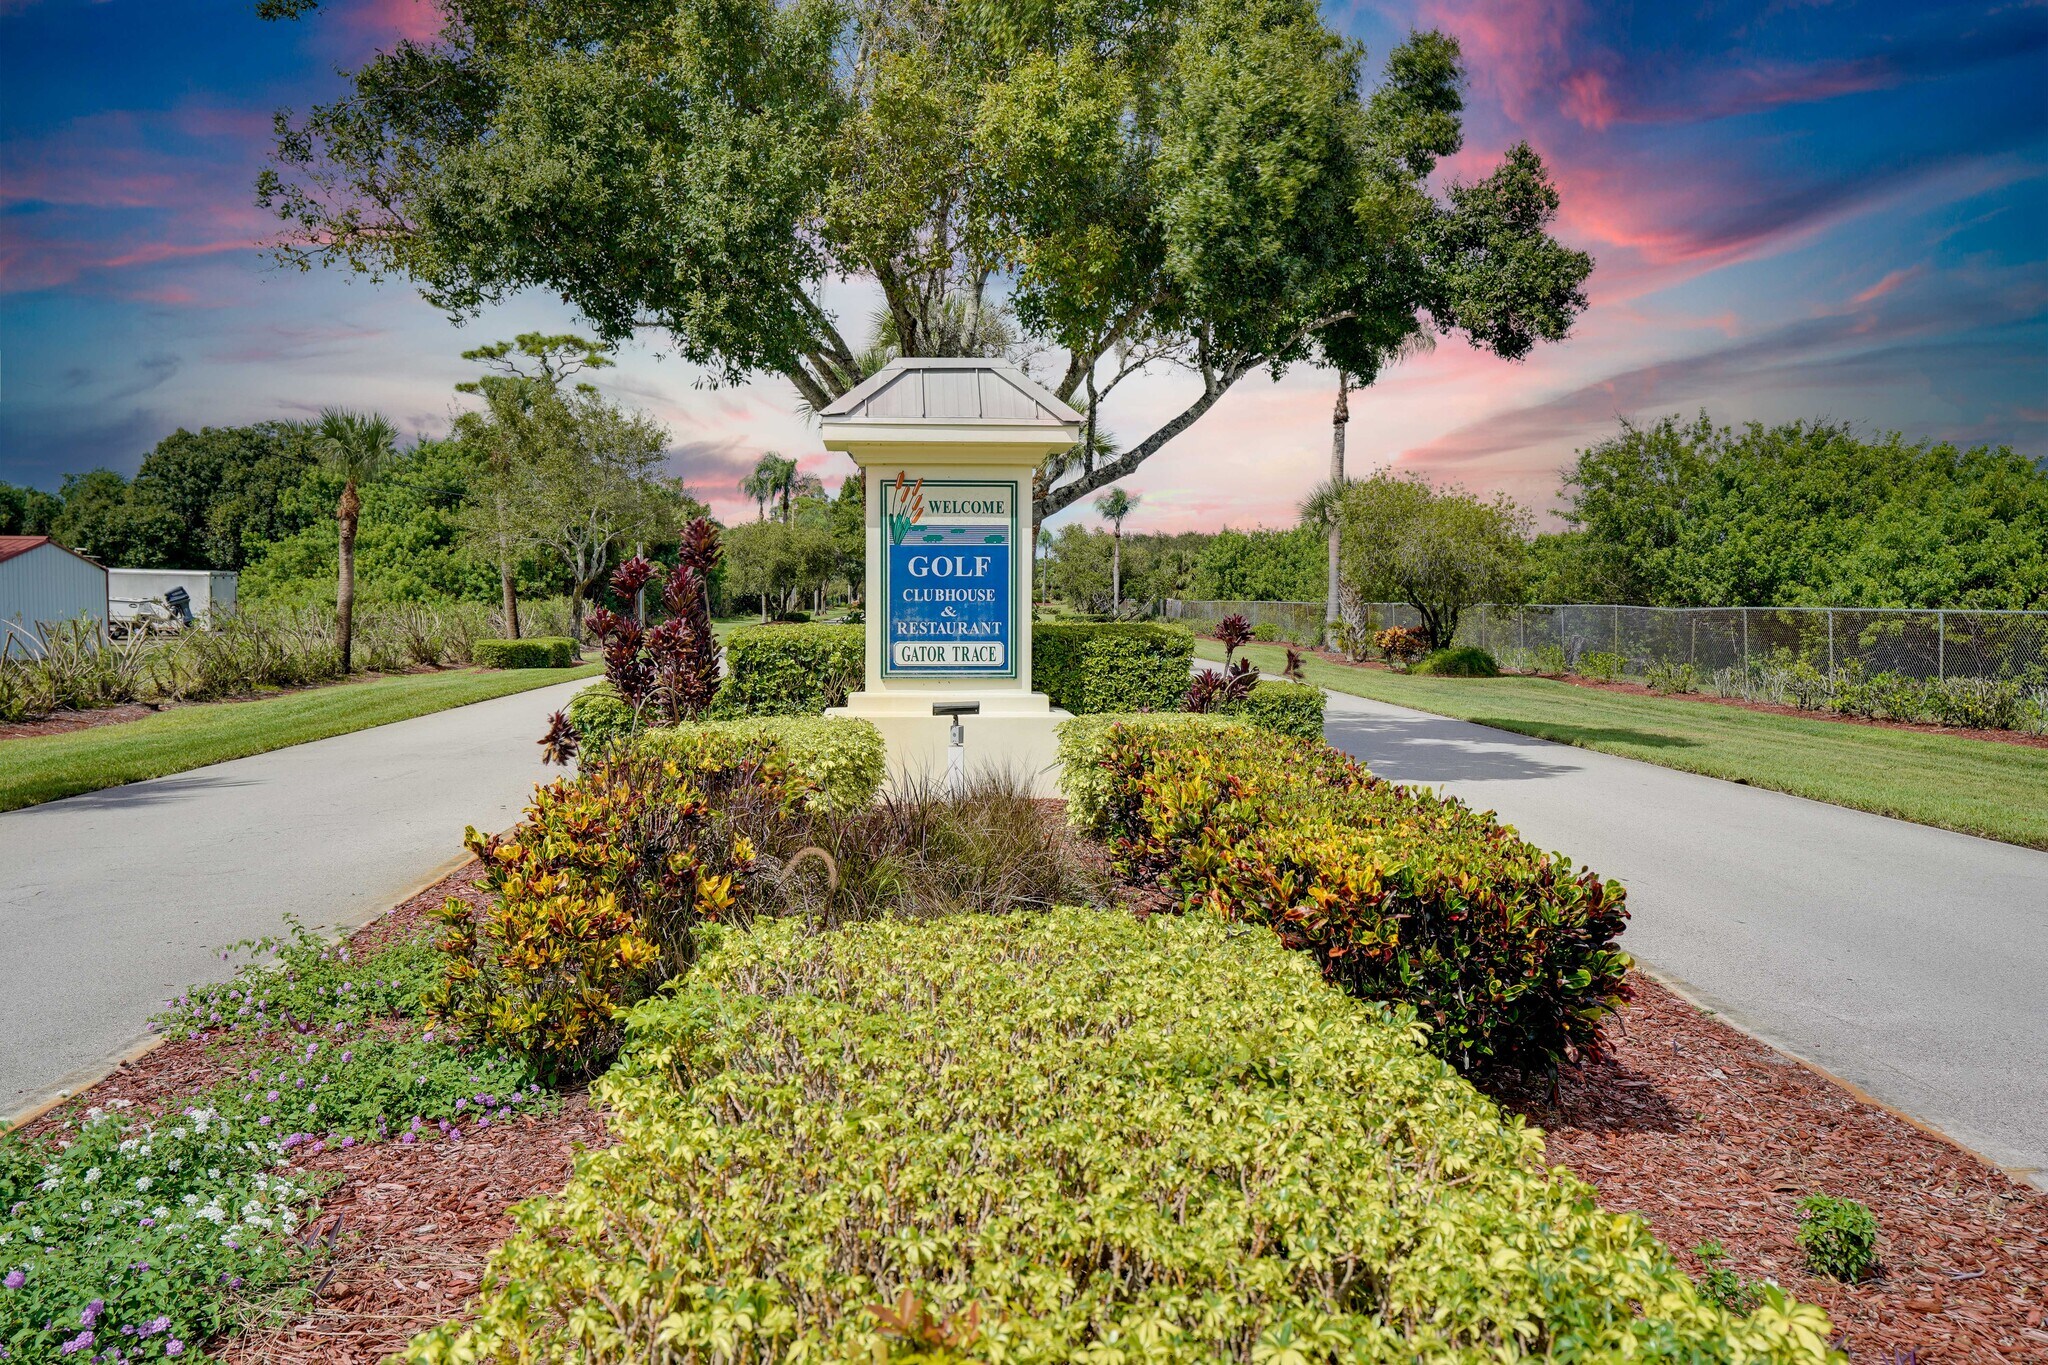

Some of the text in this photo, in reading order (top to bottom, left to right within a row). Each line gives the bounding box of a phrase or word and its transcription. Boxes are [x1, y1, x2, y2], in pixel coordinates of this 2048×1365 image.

[929, 500, 1005, 514] WELCOME
[908, 555, 992, 578] GOLF
[902, 588, 996, 602] CLUBHOUSE
[940, 605, 958, 617] &
[896, 621, 1002, 635] RESTAURANT
[901, 645, 997, 662] GATOR TRACE
